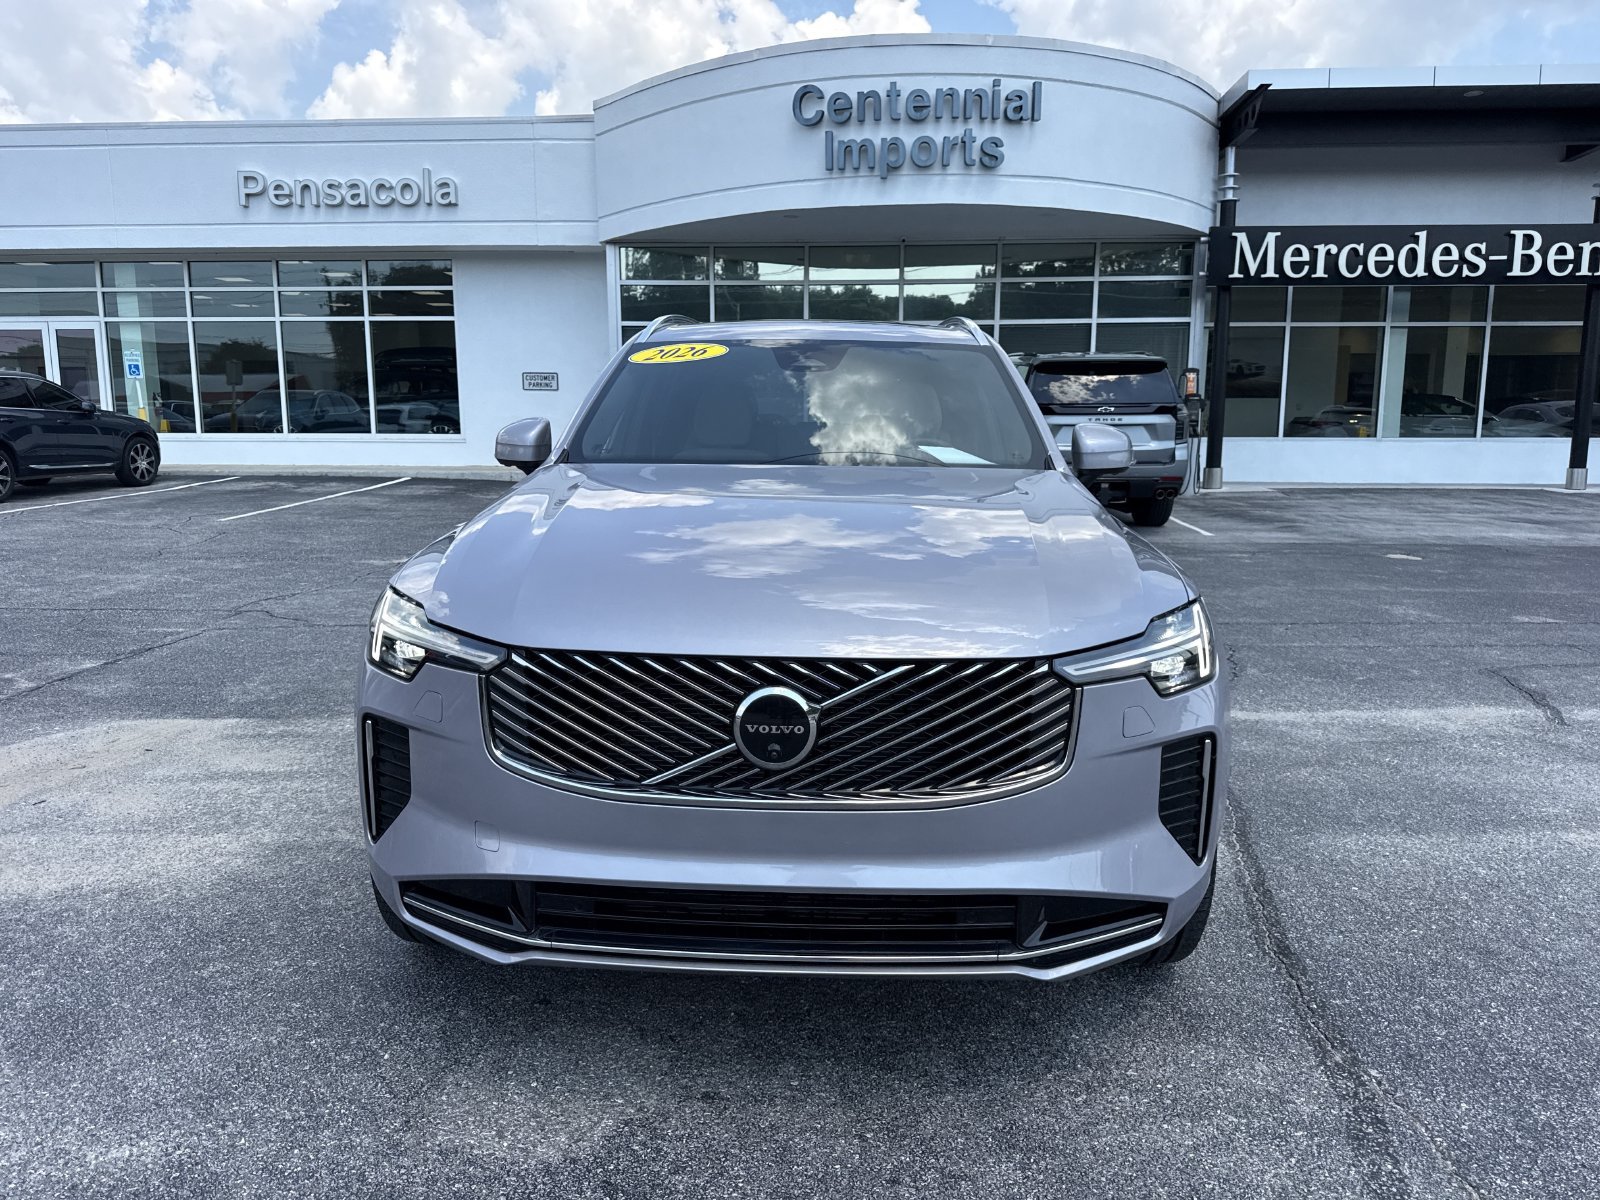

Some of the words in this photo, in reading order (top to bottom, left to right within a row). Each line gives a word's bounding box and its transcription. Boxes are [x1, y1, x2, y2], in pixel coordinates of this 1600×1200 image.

[792, 79, 1042, 127] Centennial
[825, 128, 1005, 179] Imports
[237, 168, 459, 208] Pensacola
[1228, 230, 1600, 278] Mercedes-Ben
[642, 345, 715, 362] 2026
[745, 724, 805, 734] VOLVO
